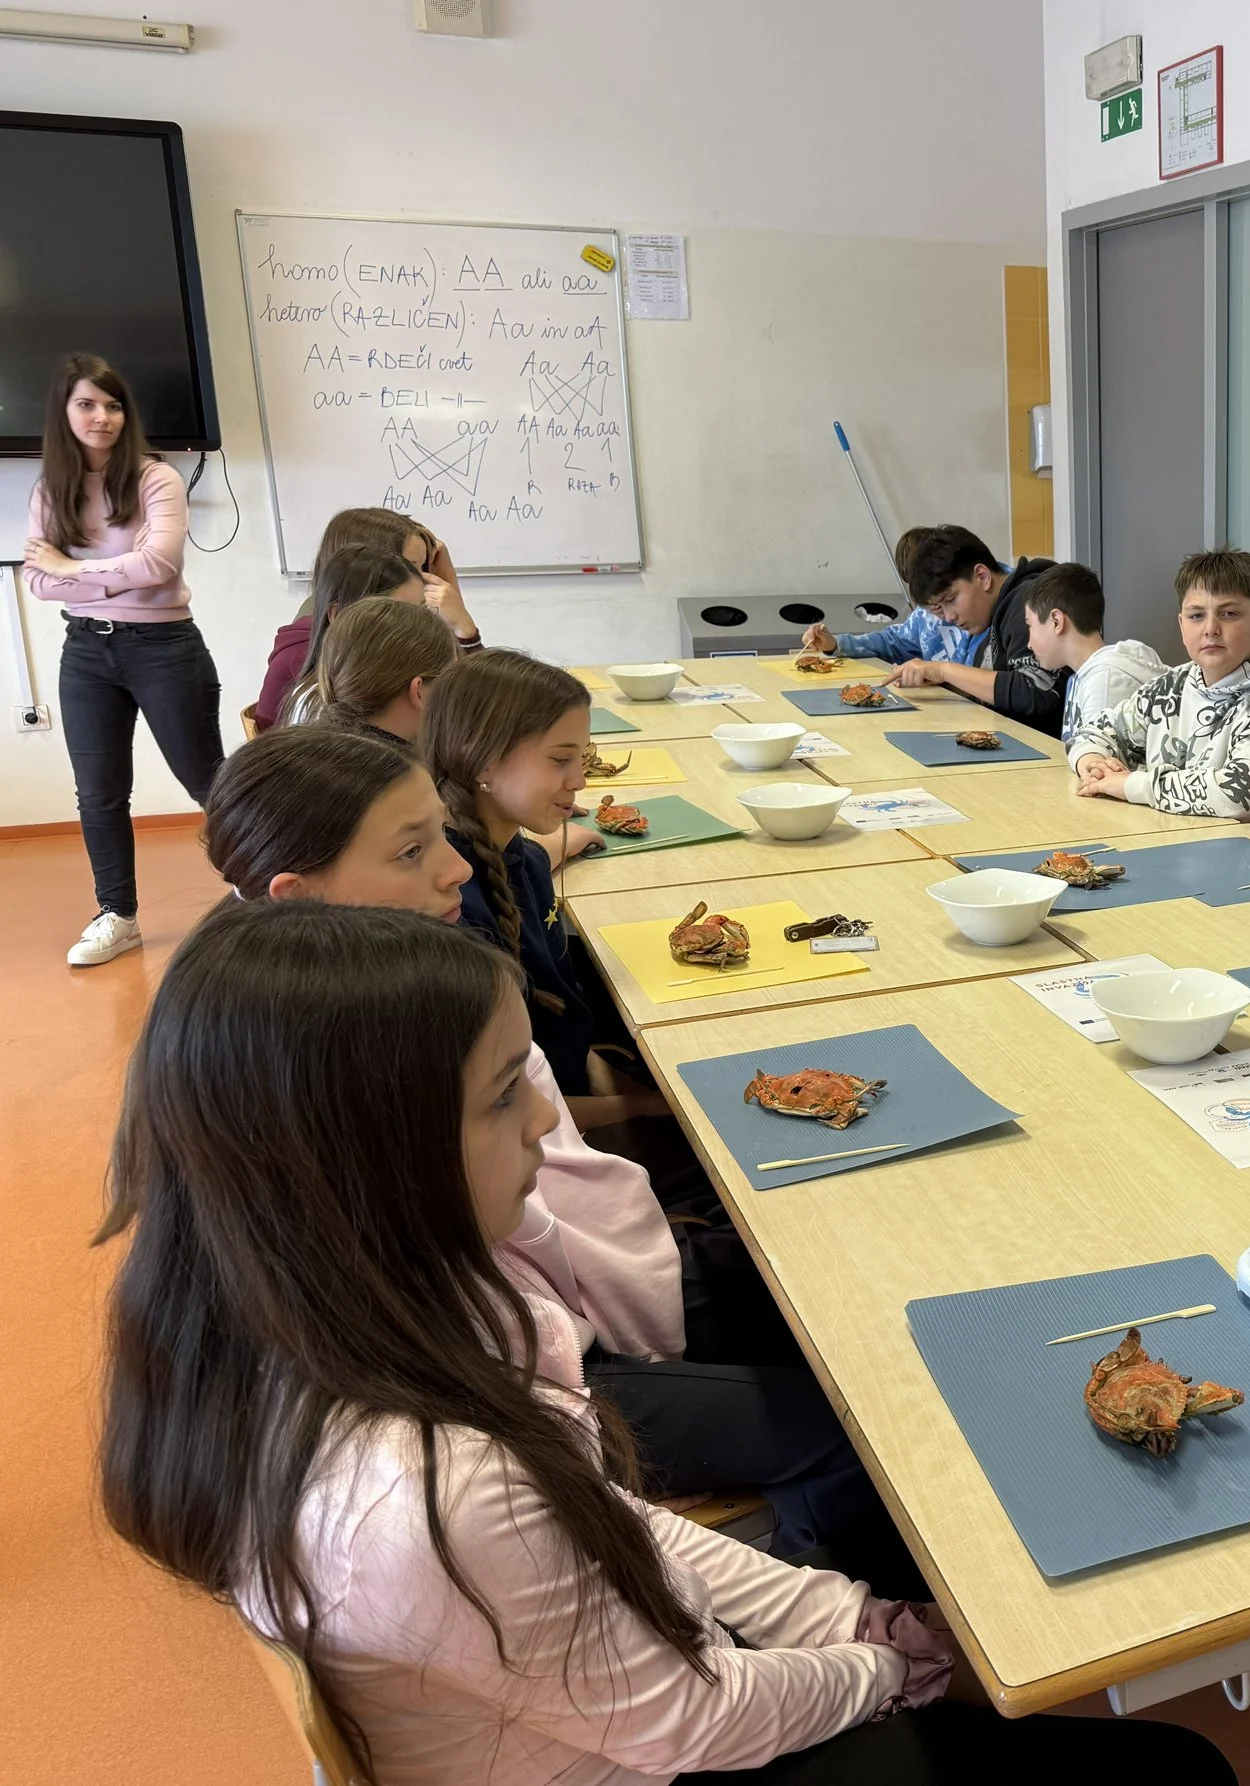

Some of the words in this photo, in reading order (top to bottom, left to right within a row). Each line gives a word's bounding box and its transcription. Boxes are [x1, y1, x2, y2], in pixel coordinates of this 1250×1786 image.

[458, 254, 505, 288] AA
[521, 267, 552, 290] ali
[562, 275, 599, 292] aa
[489, 308, 535, 340] Aa
[540, 318, 570, 339] in
[574, 315, 608, 350] aA
[439, 351, 473, 371] cvet
[520, 350, 560, 377] Aa
[580, 350, 616, 377] Aa
[313, 391, 352, 410] aa
[380, 386, 430, 409] BELI
[380, 416, 418, 443] AA
[457, 419, 500, 436] aa
[517, 413, 540, 444] AA
[564, 442, 587, 472] 2
[422, 485, 453, 508] Aa
[468, 500, 497, 523] Aa
[506, 495, 543, 522] Aa
